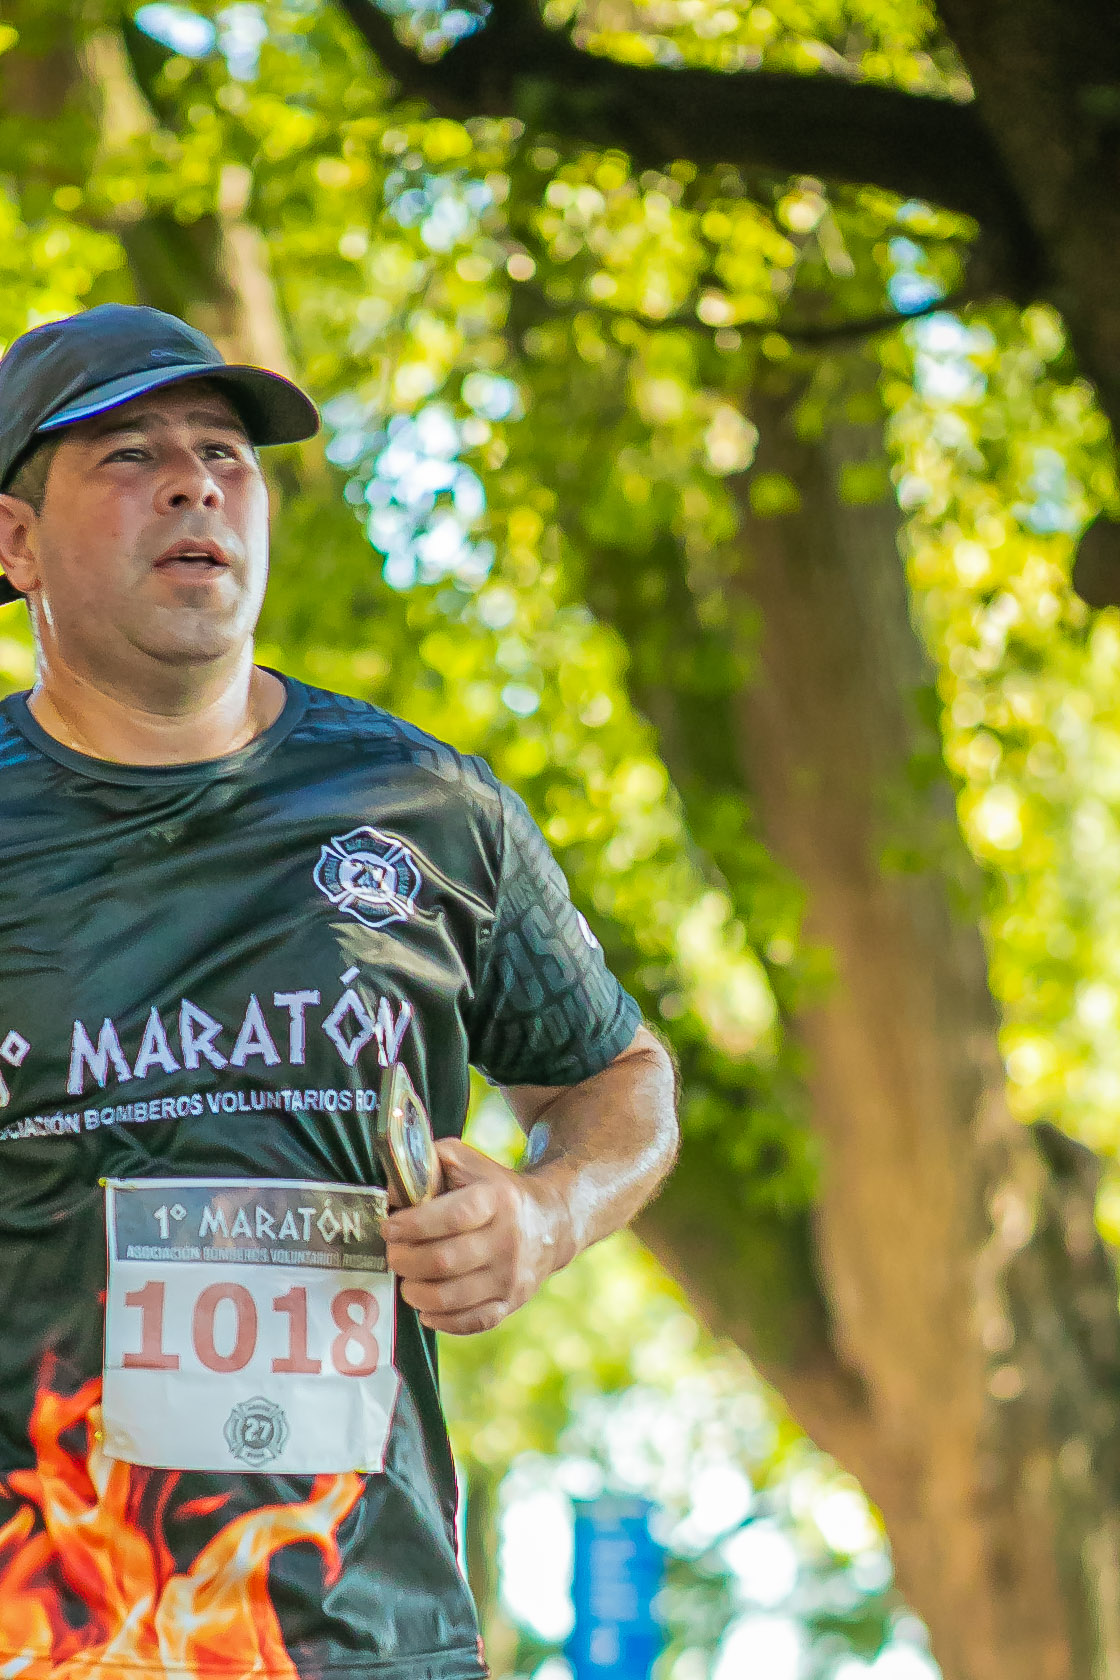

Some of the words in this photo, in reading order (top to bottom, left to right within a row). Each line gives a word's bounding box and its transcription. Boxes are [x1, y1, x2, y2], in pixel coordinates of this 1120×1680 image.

[66, 966, 413, 1096] MARATÓN
[83, 1092, 204, 1131] BOMBEROS
[206, 1088, 352, 1115] VOLUNTARIOS
[198, 1198, 362, 1244] MARATÓN
[122, 1280, 380, 1378] 1018
[244, 1416, 271, 1442] 27
